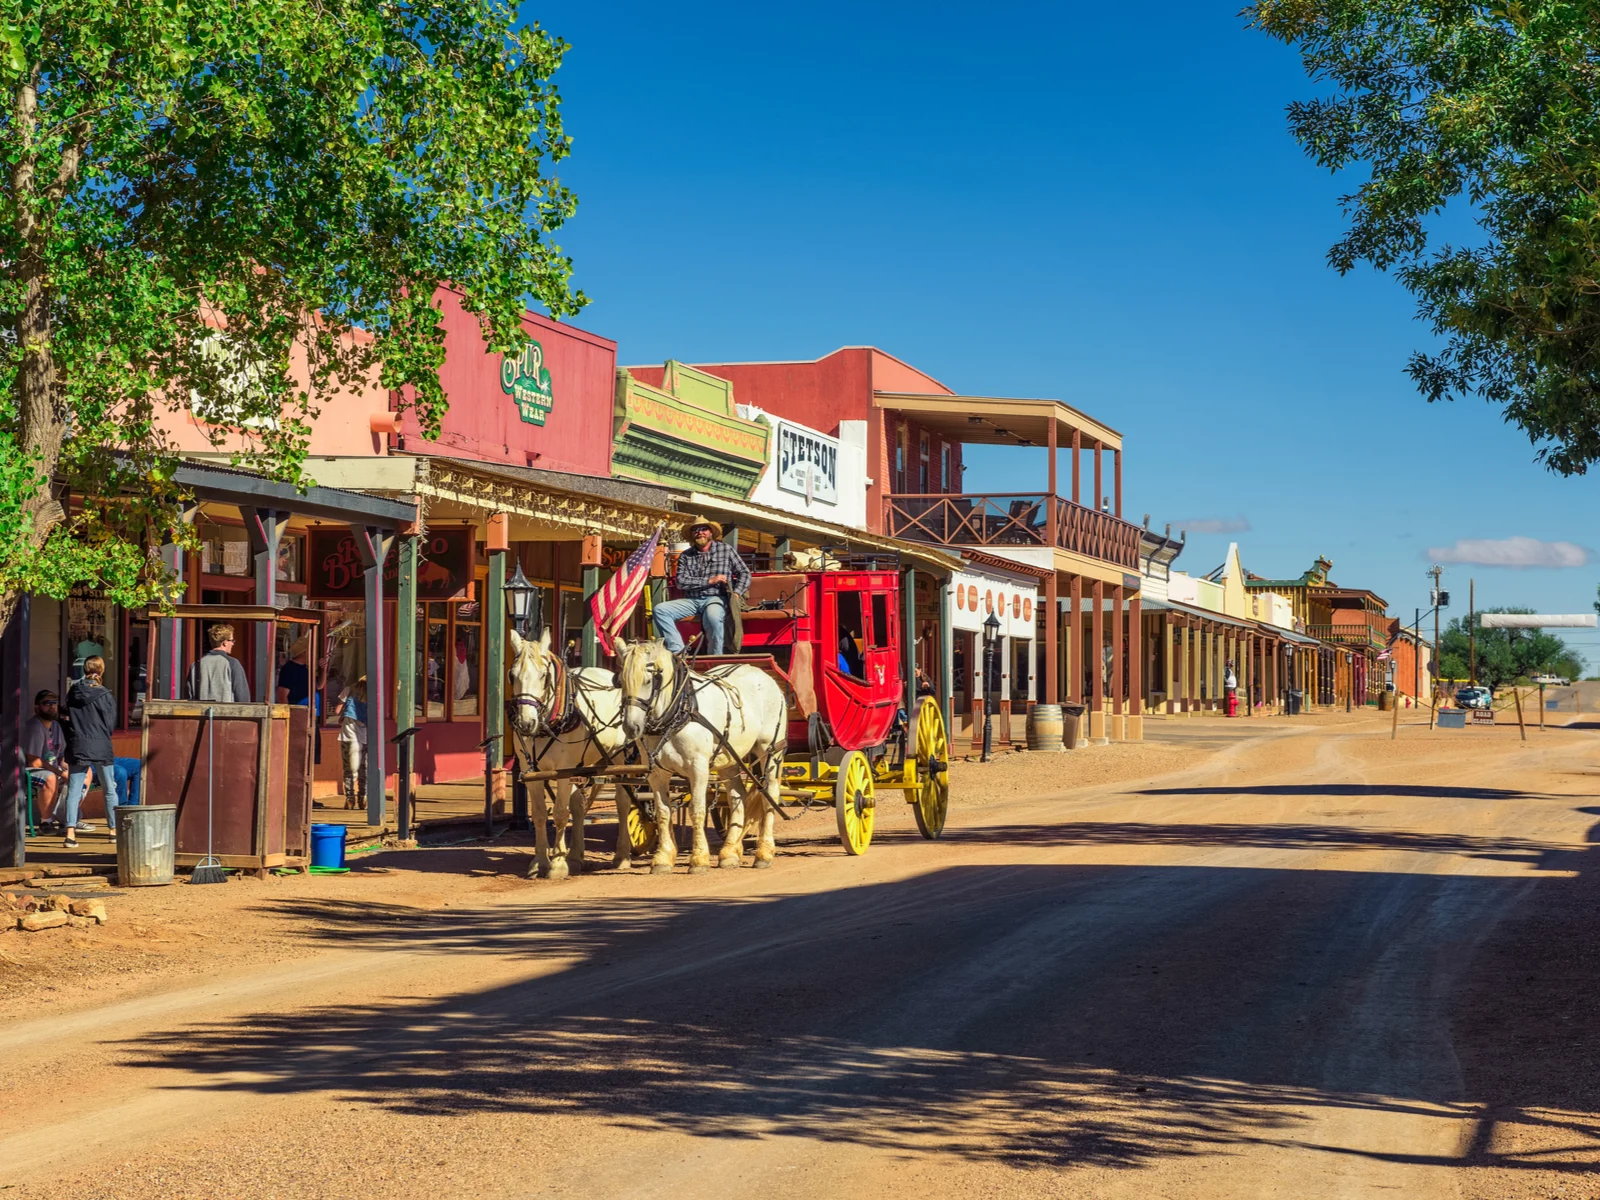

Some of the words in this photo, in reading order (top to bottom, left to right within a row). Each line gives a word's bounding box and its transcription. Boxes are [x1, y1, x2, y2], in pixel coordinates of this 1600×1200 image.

[503, 342, 543, 388] SPUR
[514, 384, 553, 408] WESTERN
[521, 401, 546, 421] WEAR
[782, 429, 837, 491] STETSON
